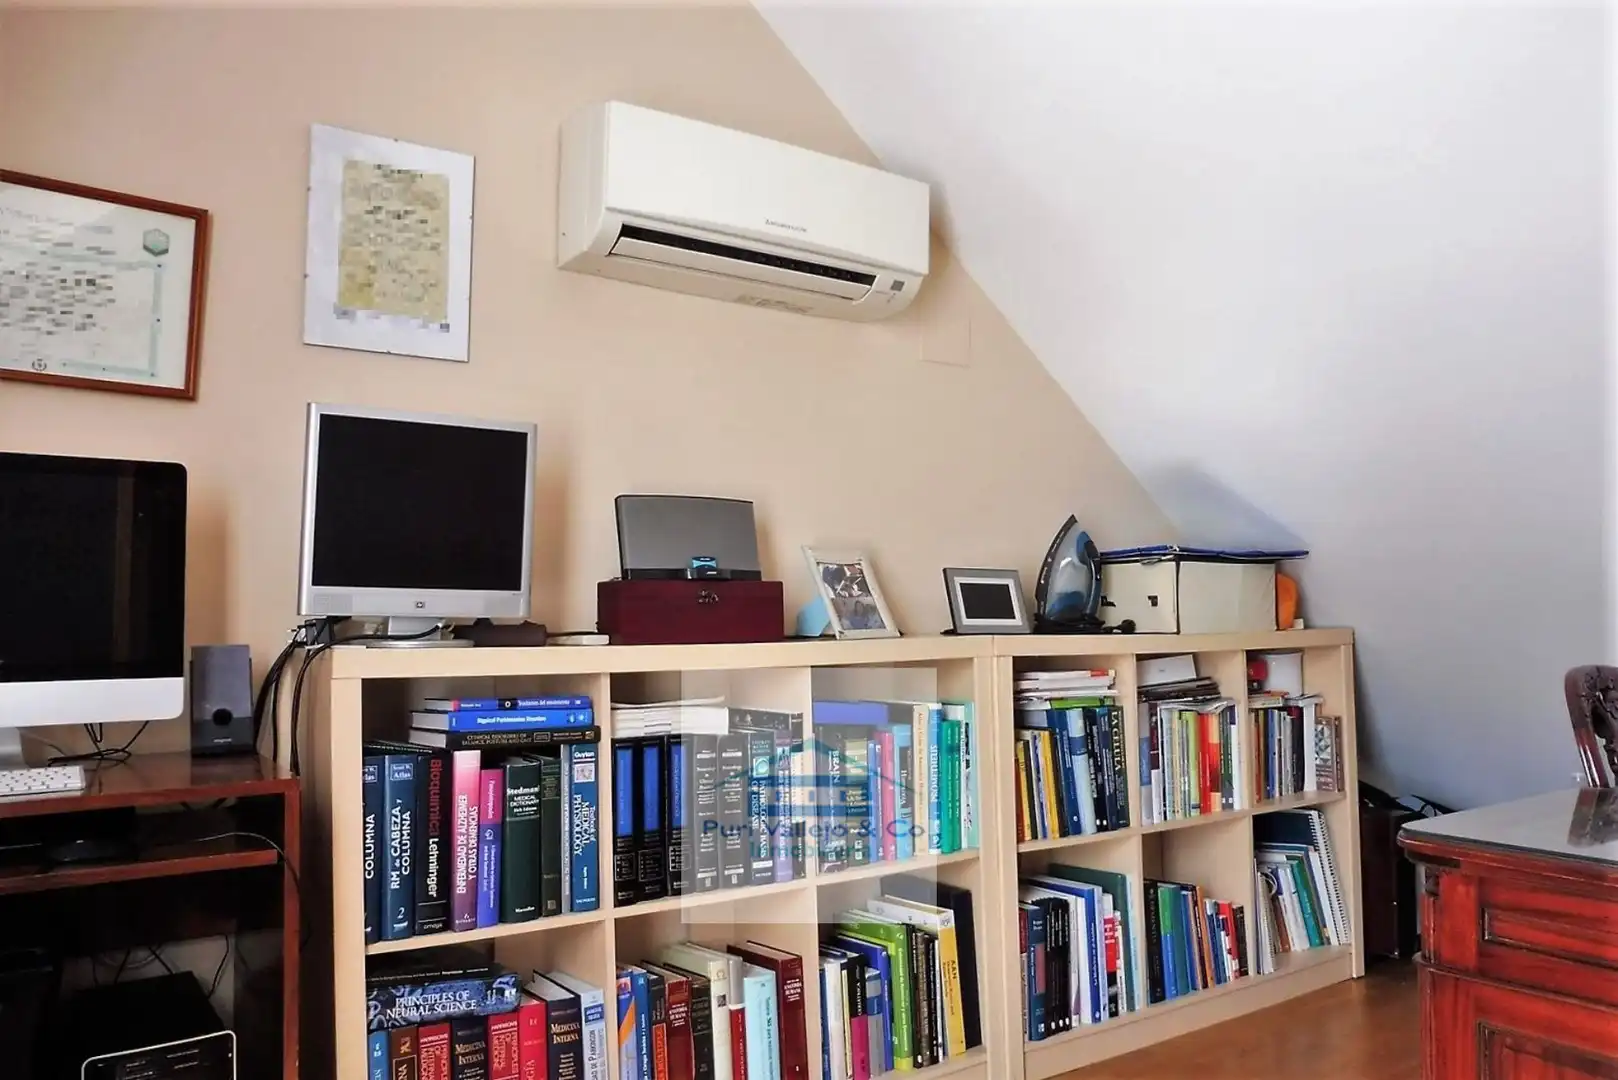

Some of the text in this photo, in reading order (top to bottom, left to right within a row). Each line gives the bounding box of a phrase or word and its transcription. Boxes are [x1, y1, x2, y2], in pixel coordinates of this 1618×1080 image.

[1111, 711, 1118, 725] LA
[751, 781, 759, 792] OF
[469, 806, 478, 848] DEMENCIAS
[573, 795, 582, 856] PHYSIOLOGY
[581, 802, 590, 846] MEDICAL
[759, 780, 769, 858] PATHOLOGIC BASIS
[391, 806, 400, 857] CABEZA
[365, 814, 375, 879] COLUMNA
[401, 811, 411, 875] COLUMNA
[457, 795, 467, 894] ENFERMEDAD DE ALZHEIMER
[427, 838, 439, 897] Lehninger
[469, 849, 477, 873] OTRAS
[391, 876, 400, 889] RM
[397, 907, 405, 919] 2
[386, 1000, 477, 1020] NEURAL SCIENCE
[395, 991, 471, 1009] PRINCIPLES OF
[550, 1021, 581, 1035] MEDICINA
[552, 1032, 579, 1045] INTERNA
[455, 1040, 486, 1055] MEDICINA
[458, 1053, 485, 1067] INTERNA
